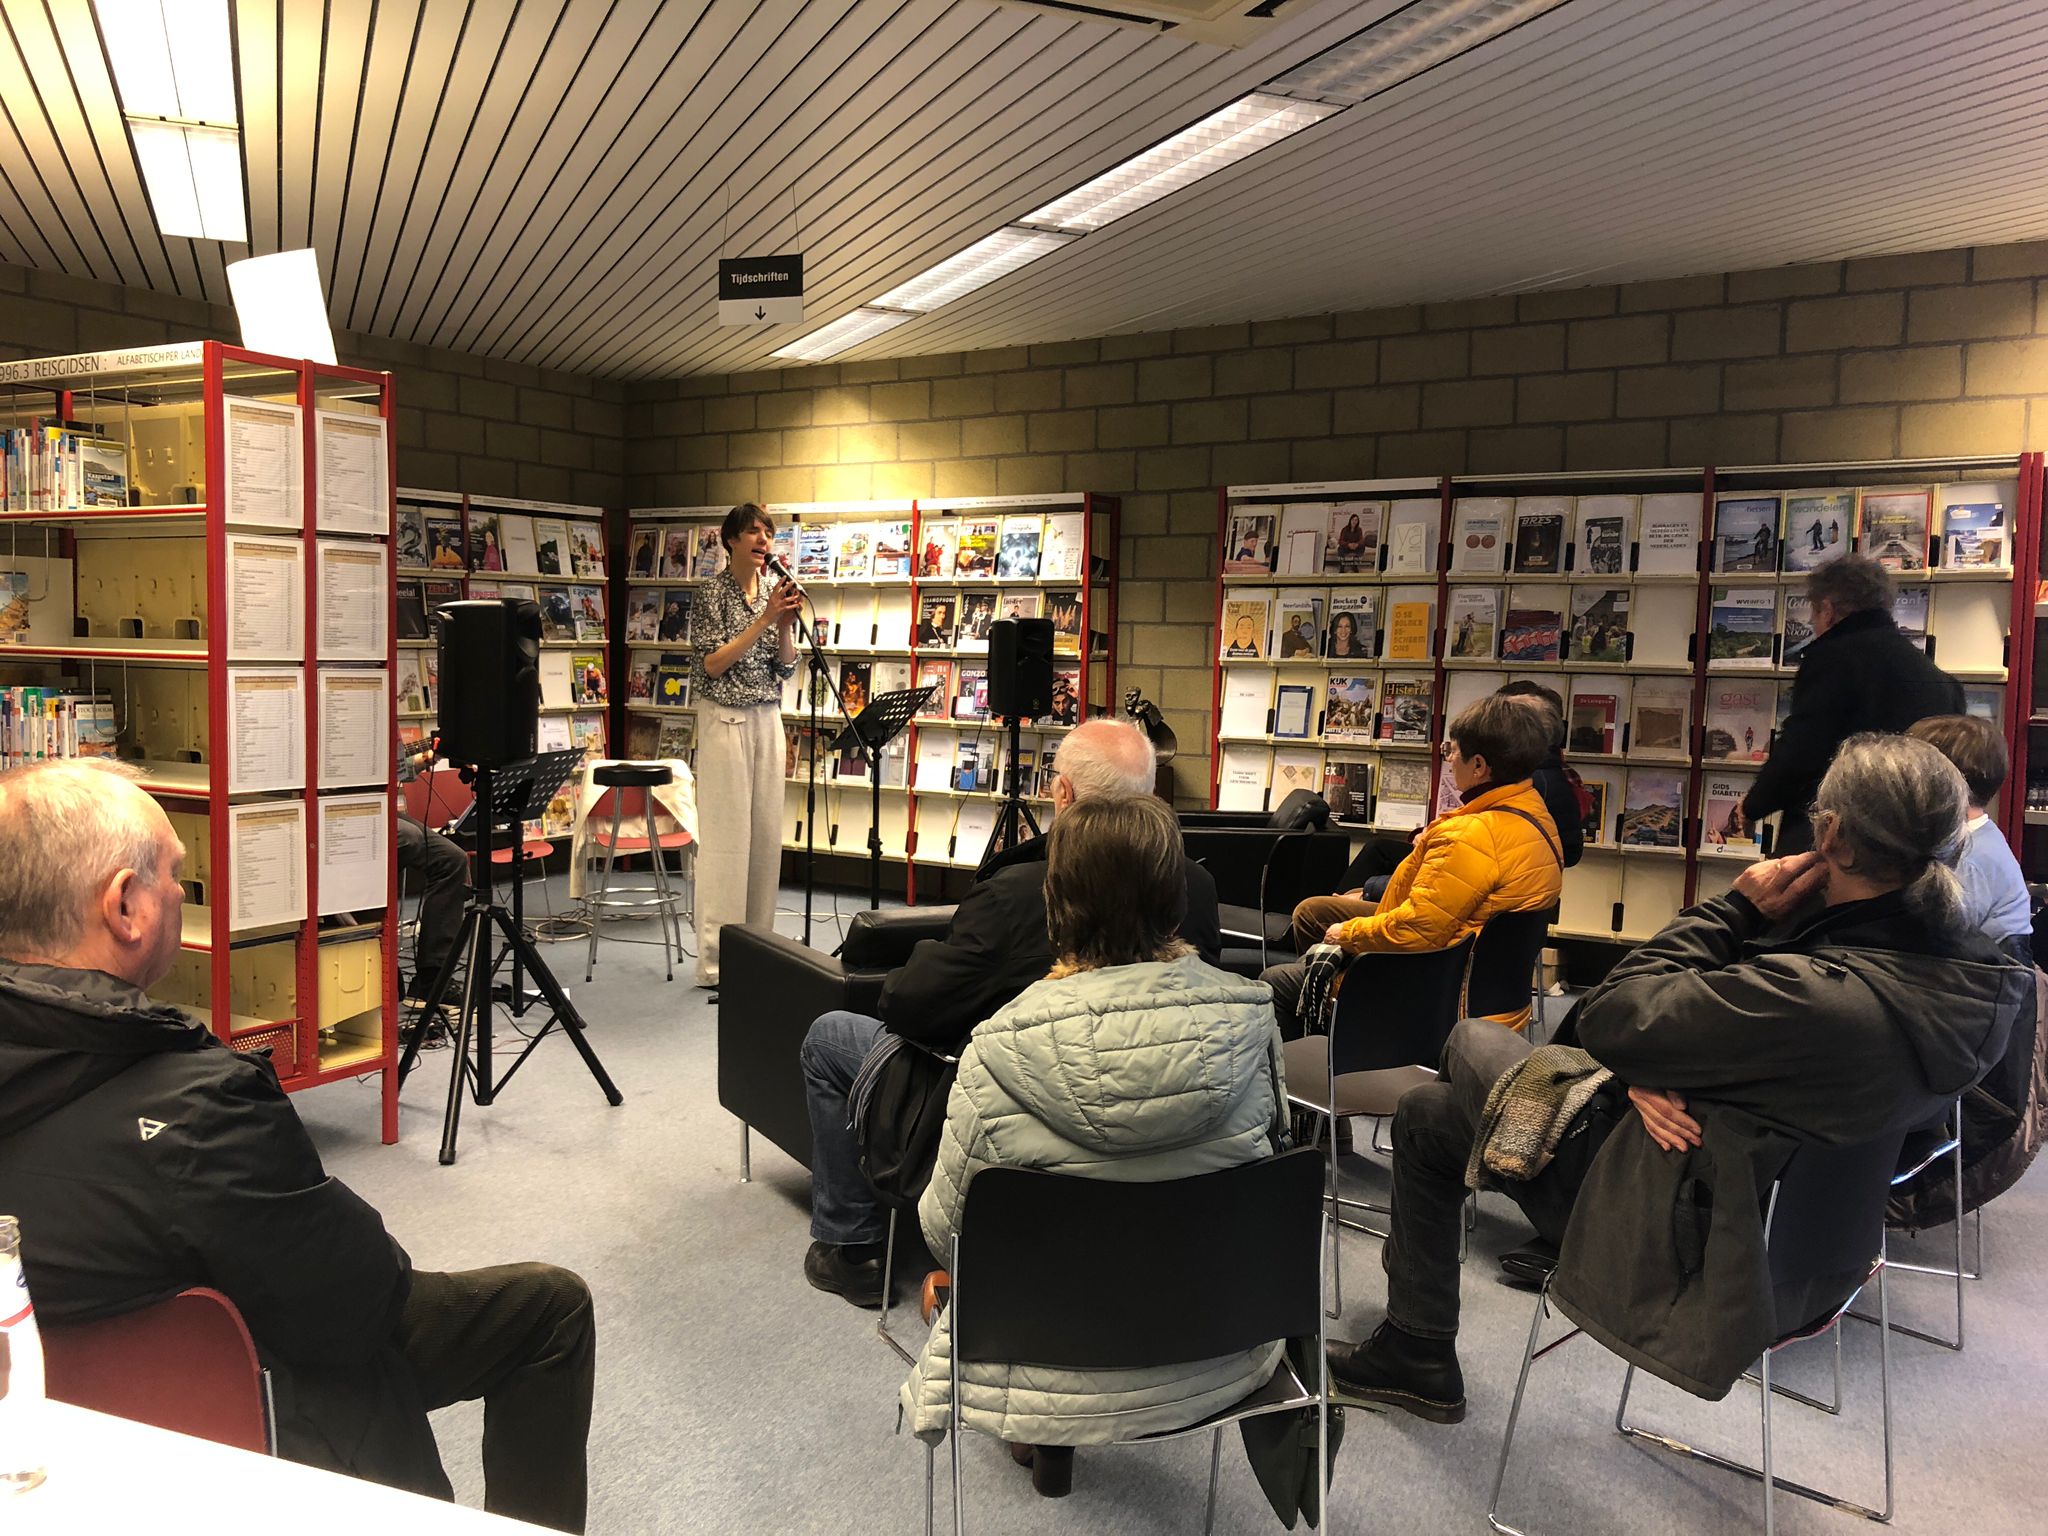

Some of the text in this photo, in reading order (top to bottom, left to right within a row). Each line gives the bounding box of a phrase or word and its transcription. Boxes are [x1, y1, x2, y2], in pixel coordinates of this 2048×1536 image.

[731, 272, 789, 285] Tijdschriften
[0, 363, 29, 382] 996.3
[35, 356, 100, 377] REISGIDSEN
[117, 352, 165, 365] ALFABETISCH
[166, 350, 179, 361] PER
[181, 348, 202, 360] LAND
